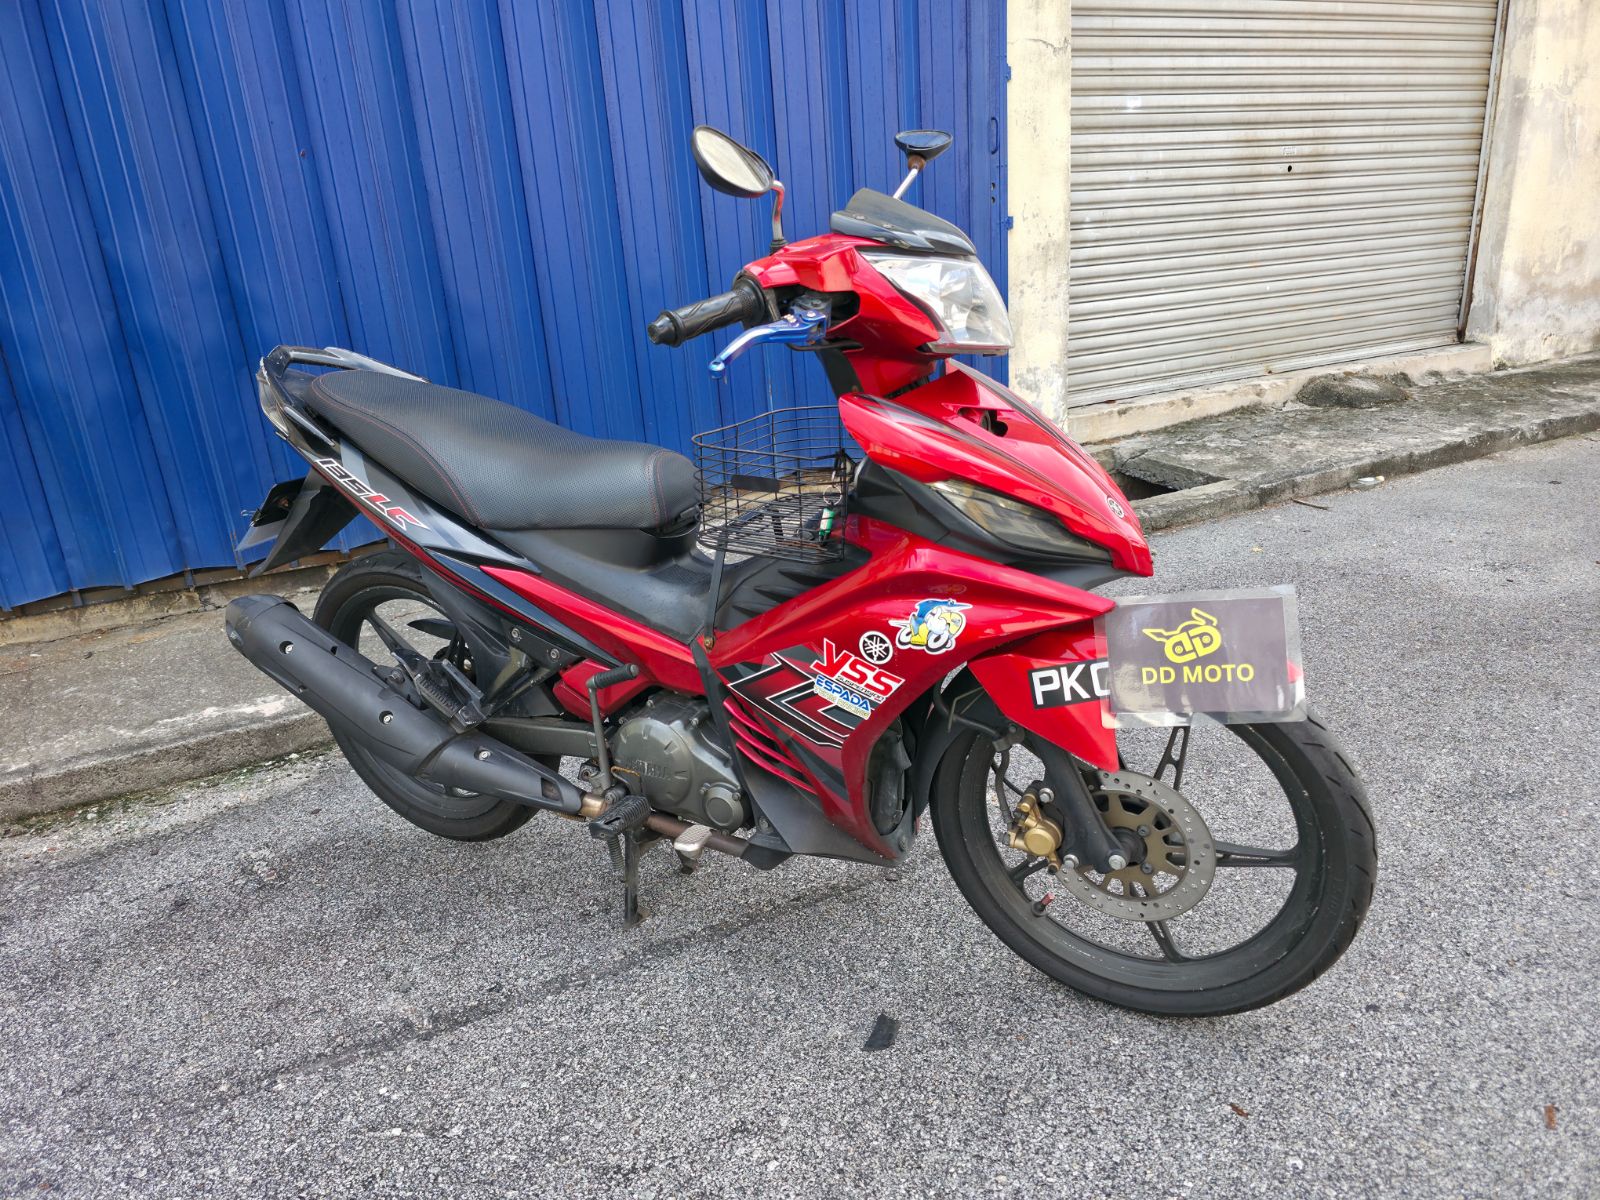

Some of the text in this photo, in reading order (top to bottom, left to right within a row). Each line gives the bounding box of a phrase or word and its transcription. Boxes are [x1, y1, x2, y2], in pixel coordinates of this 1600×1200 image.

[315, 458, 431, 531] 135LC
[810, 638, 905, 698] YSS
[1141, 663, 1255, 685] DD MOTO
[815, 675, 870, 711] ESPADA
